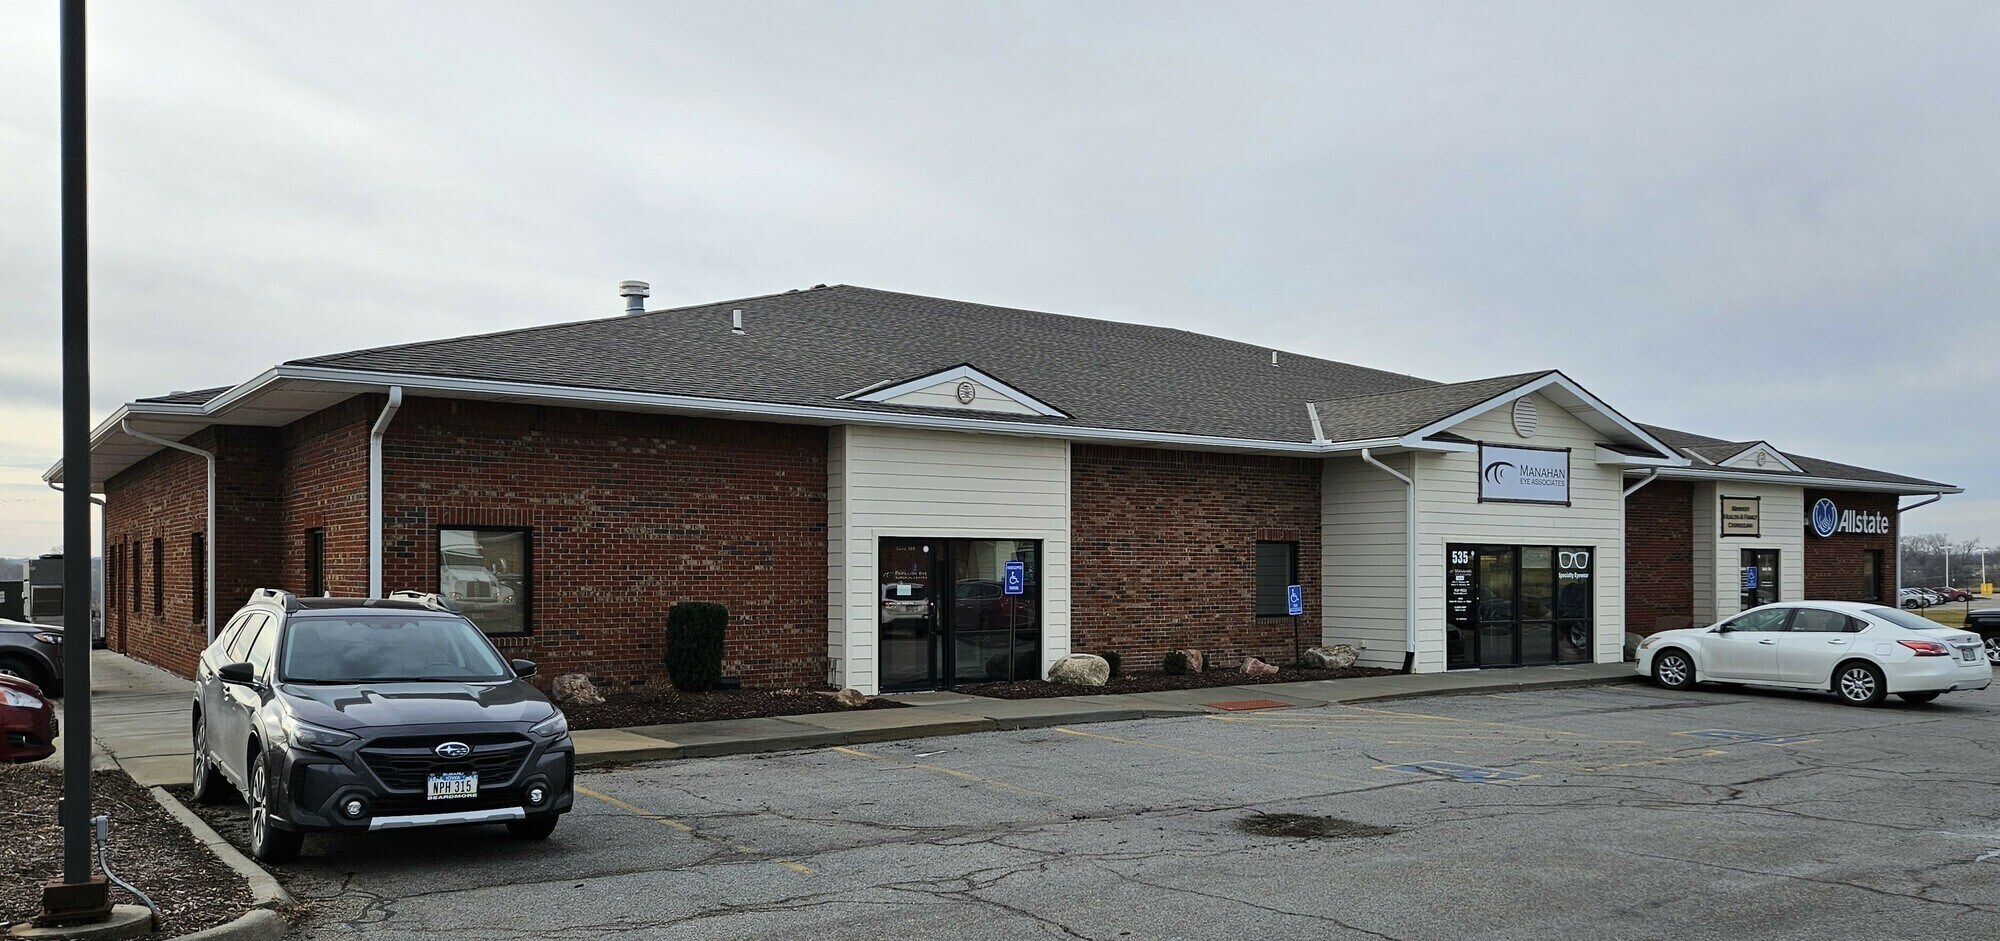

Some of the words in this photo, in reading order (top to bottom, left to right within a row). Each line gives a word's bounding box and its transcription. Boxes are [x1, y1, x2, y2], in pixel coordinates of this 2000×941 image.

[1520, 464, 1566, 479] MANAHAN
[1520, 477, 1531, 485] EYE
[1531, 479, 1566, 487] ASSOCIATES
[1837, 509, 1889, 534] Allstate
[1451, 550, 1469, 564] 535
[1558, 572, 1574, 580] Specialty
[1574, 572, 1589, 580] Eyewear
[433, 781, 451, 794] NPH
[454, 780, 472, 793] 315
